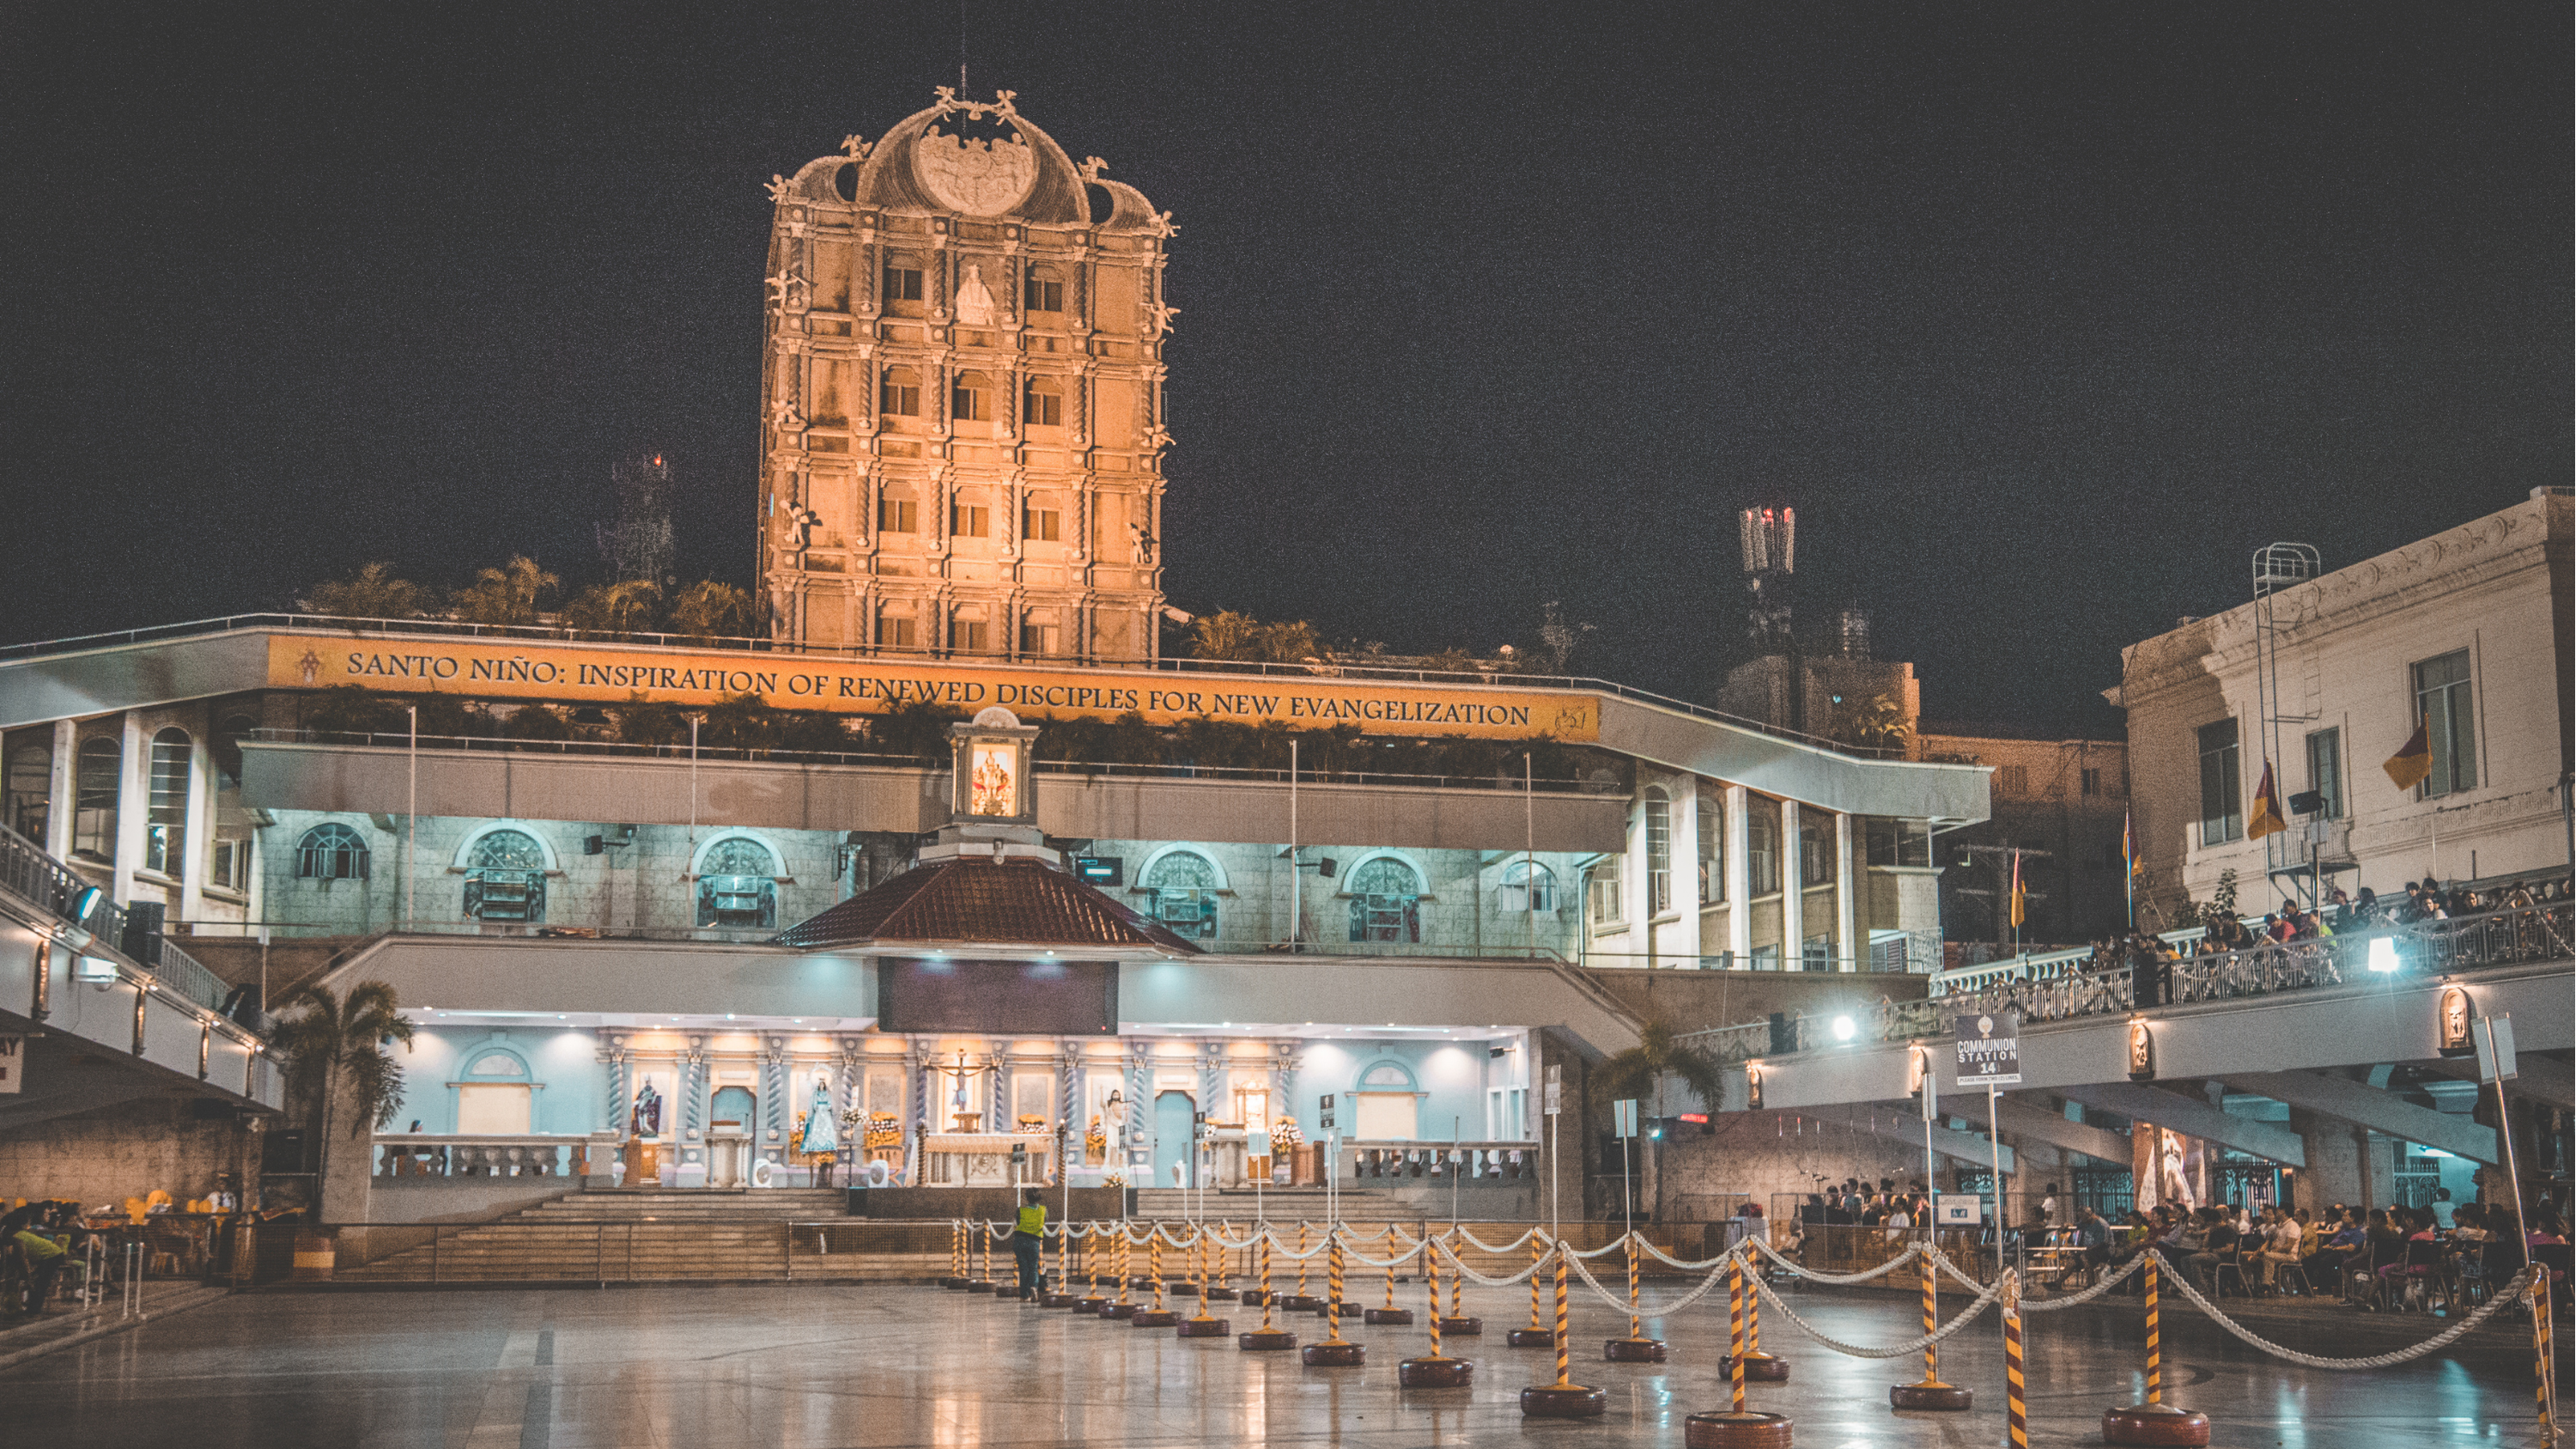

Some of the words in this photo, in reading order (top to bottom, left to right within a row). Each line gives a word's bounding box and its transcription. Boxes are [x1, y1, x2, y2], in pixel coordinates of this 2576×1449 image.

[347, 653, 459, 679] SANTO
[470, 655, 566, 684] NIÑO:
[578, 664, 777, 694] INSPIRATION
[788, 674, 829, 696] OF
[838, 677, 986, 703] RENEWED
[996, 684, 1139, 709] DISCIPLES
[1149, 691, 1204, 713] FOR
[1213, 693, 1280, 715] NEW
[1291, 697, 1529, 726] EVANGELIZATION
[1958, 1038, 2016, 1053] COMMUNION
[1959, 1050, 2017, 1062] STATION
[1981, 1062, 1996, 1074] 14
